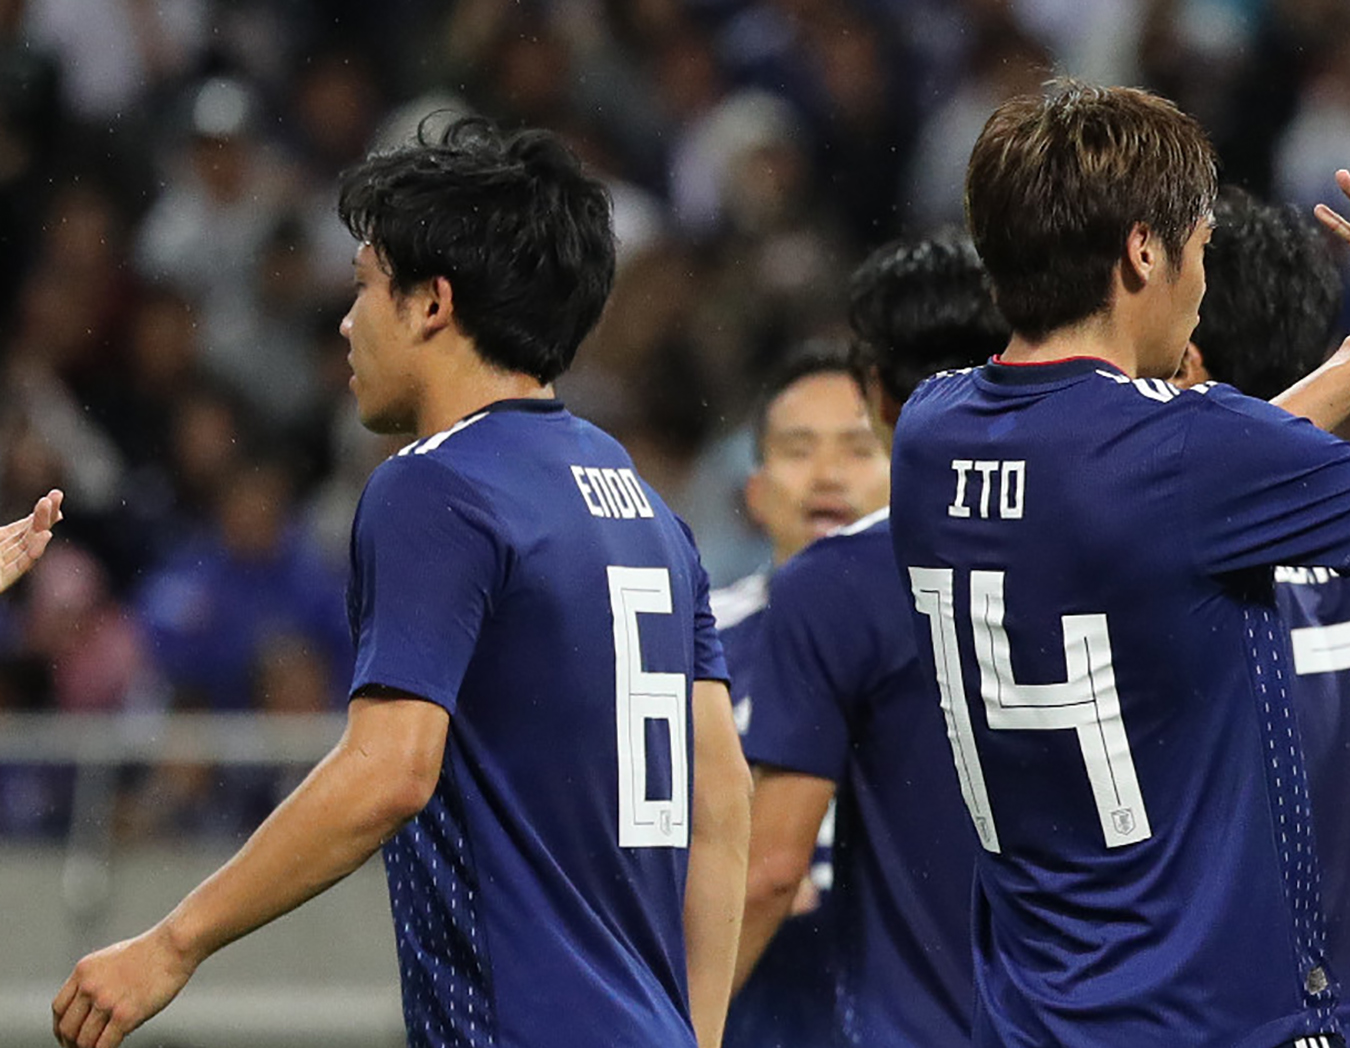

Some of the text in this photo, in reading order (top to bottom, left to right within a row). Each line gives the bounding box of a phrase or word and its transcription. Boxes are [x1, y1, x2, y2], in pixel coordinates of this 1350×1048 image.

[571, 465, 654, 519] ENDO
[948, 460, 1026, 519] ITO
[606, 566, 688, 848] 6
[908, 566, 1152, 854] 14
